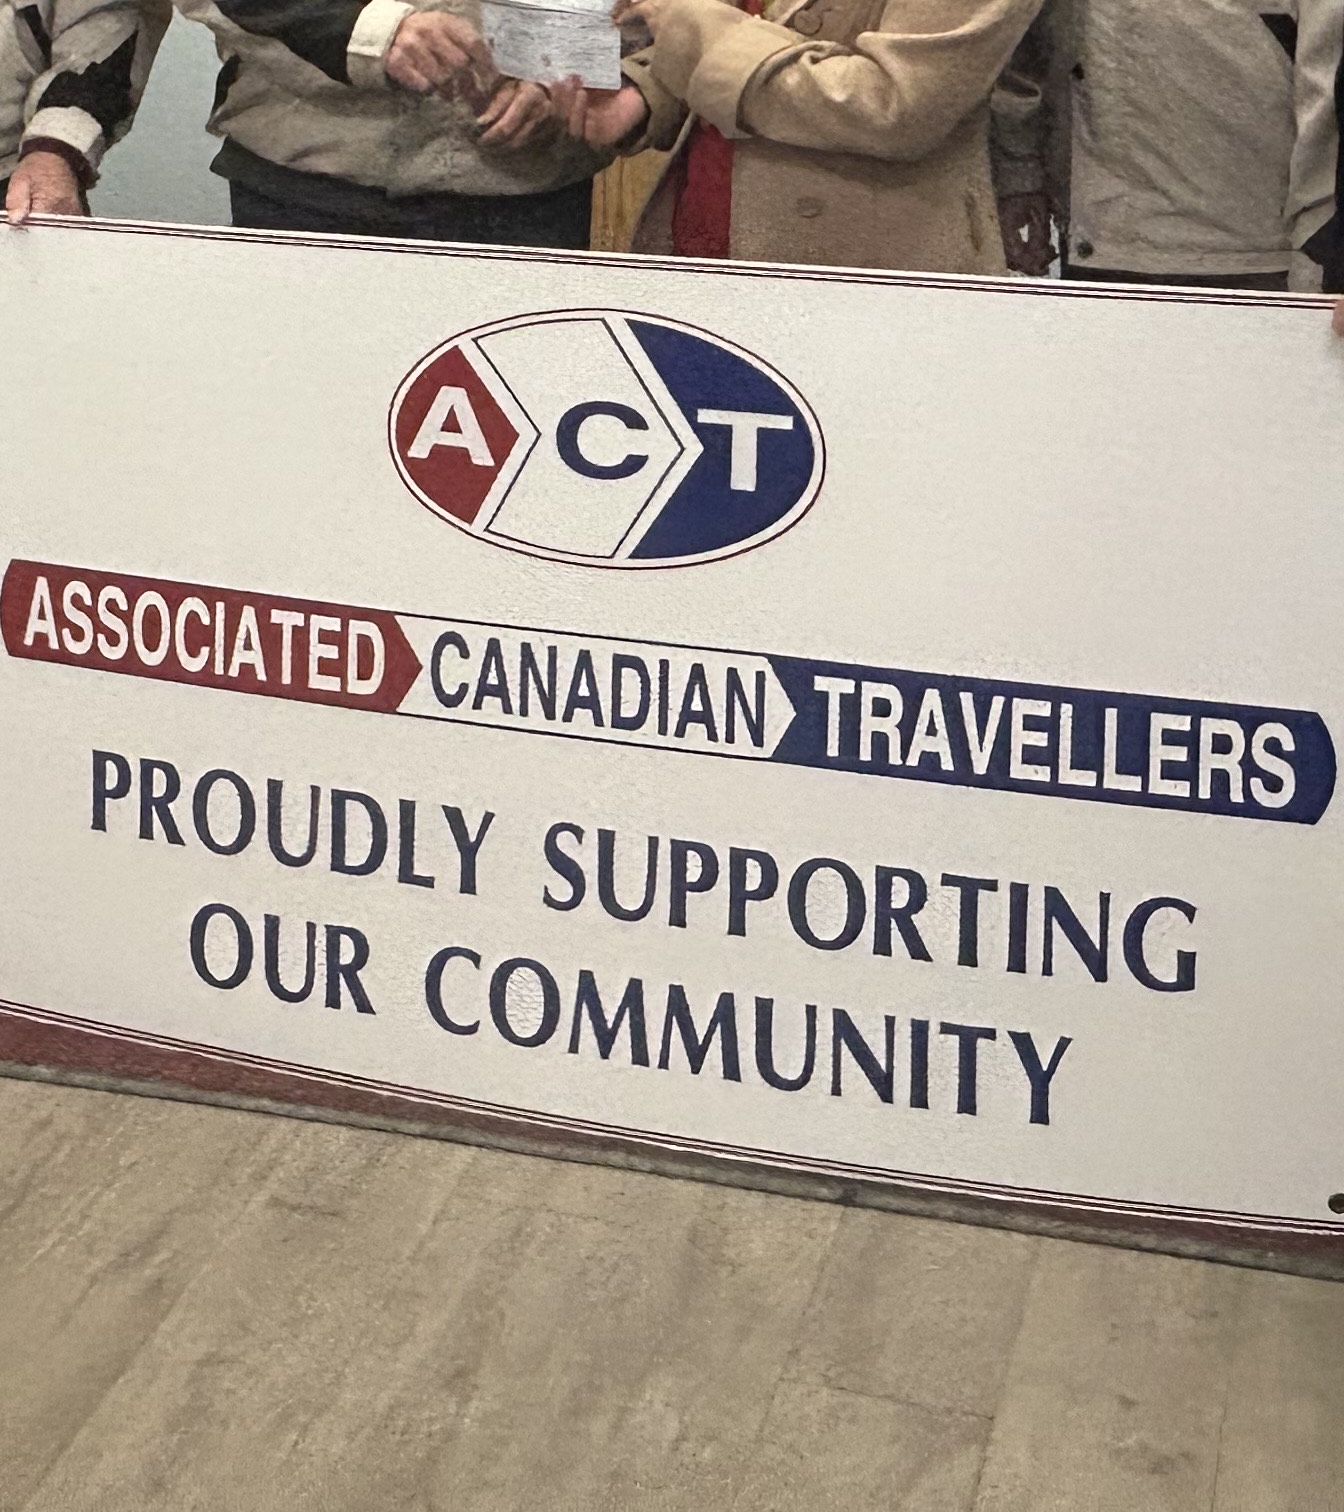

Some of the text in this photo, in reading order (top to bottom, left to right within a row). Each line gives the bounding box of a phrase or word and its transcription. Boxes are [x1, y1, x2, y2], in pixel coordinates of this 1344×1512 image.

[406, 385, 794, 492] ACT
[22, 575, 1296, 809] ASSOCIATED CANADIAN TRAVELLERS
[90, 749, 1198, 993] PROUDLY SUPPORTING
[189, 903, 1074, 1126] OUR COMMUNITY
